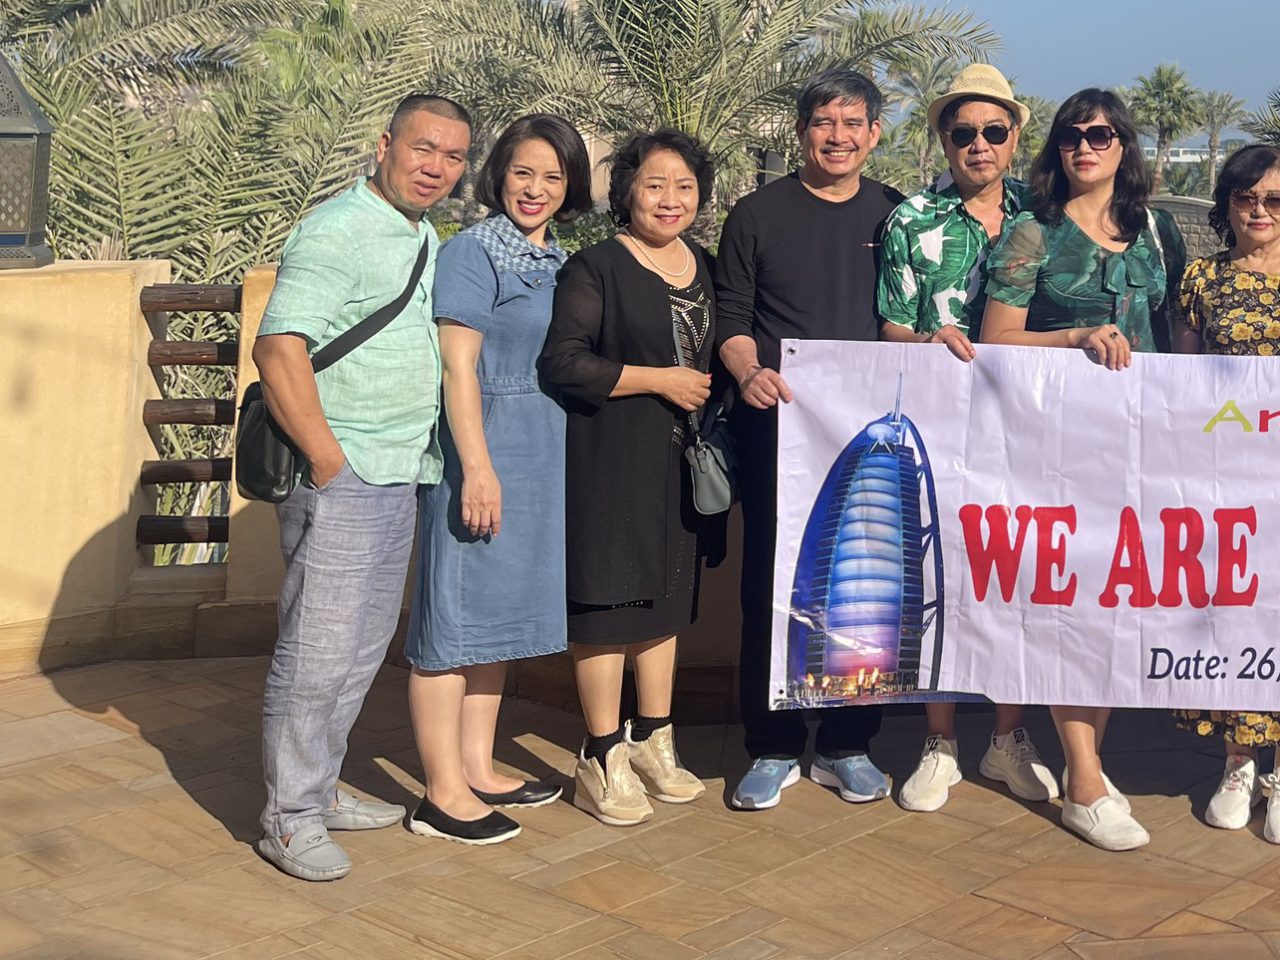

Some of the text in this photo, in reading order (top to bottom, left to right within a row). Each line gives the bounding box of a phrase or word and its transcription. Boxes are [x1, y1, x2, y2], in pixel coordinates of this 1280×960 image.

[958, 504, 1078, 607] WE
[1098, 505, 1259, 609] ARE
[1146, 647, 1229, 680] Date:
